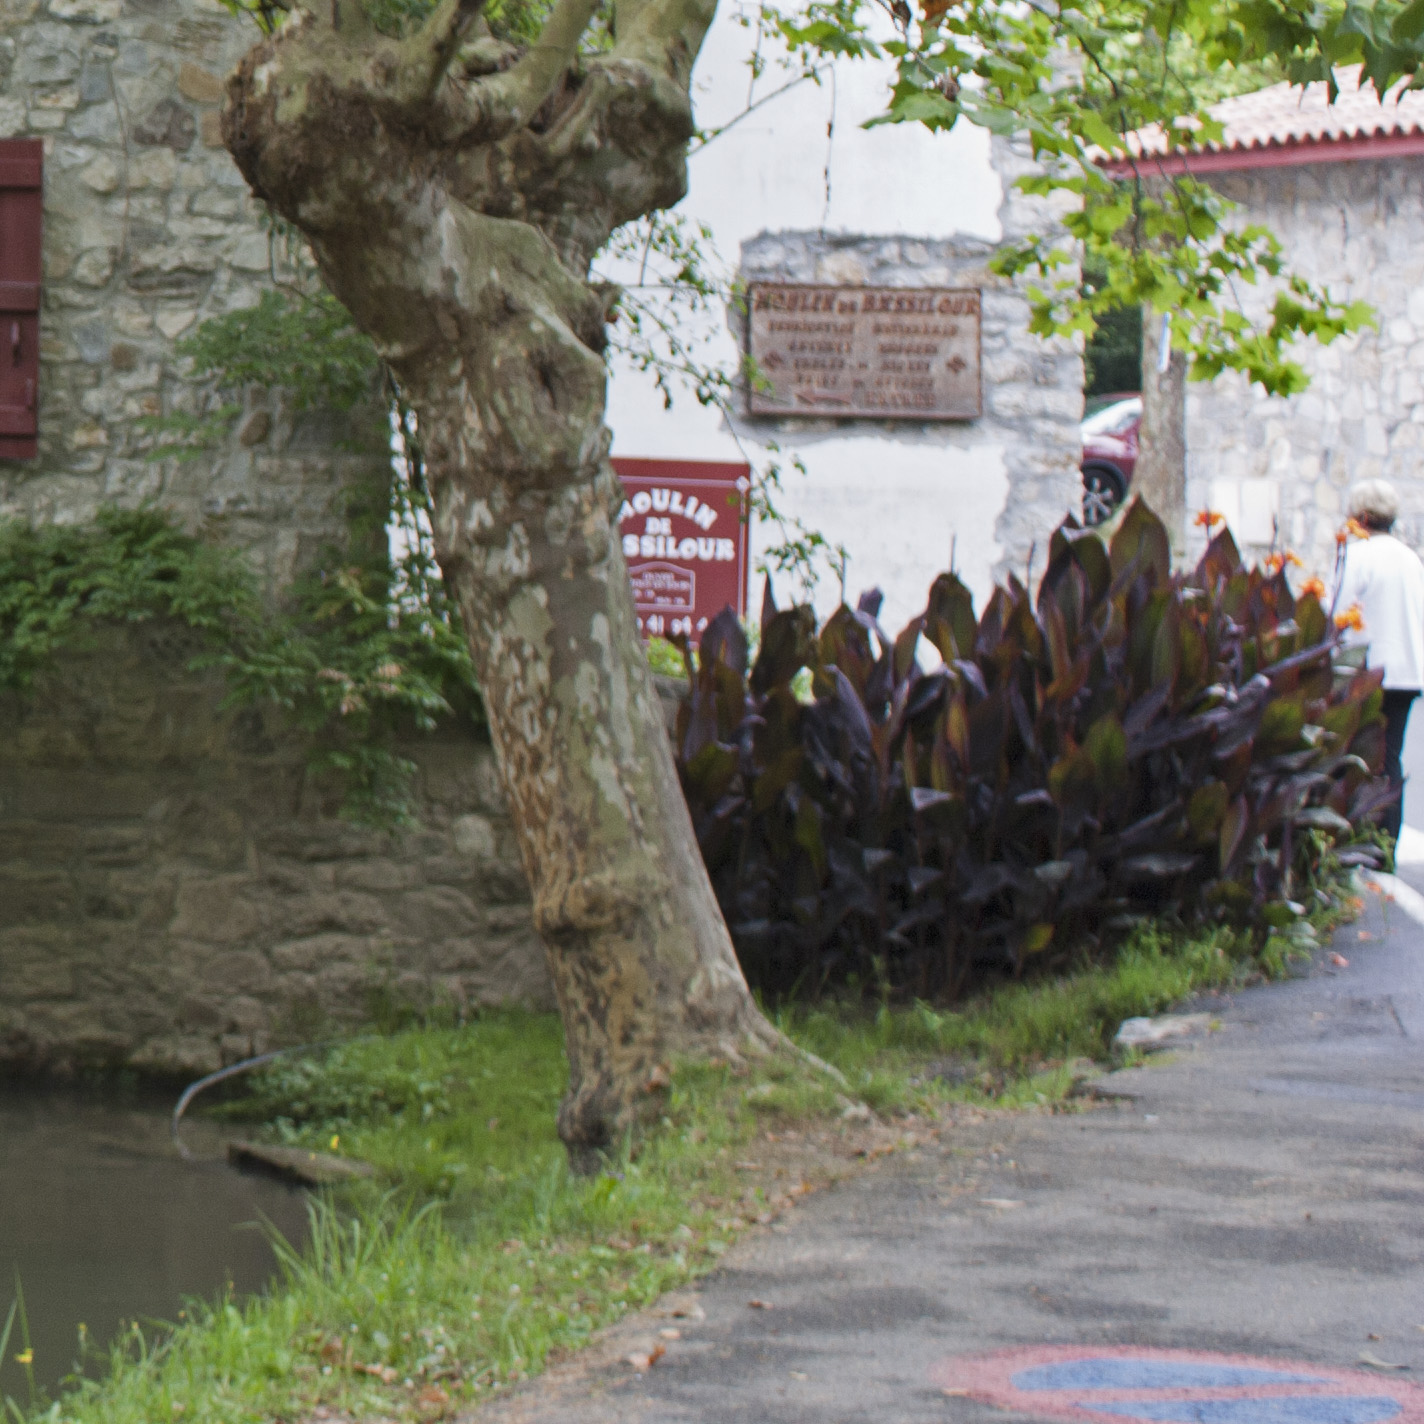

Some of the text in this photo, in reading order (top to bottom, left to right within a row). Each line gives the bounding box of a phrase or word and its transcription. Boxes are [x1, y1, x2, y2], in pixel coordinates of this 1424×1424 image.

[754, 291, 835, 312] MOULIN
[838, 299, 858, 314] DE
[645, 516, 673, 536] DE
[621, 533, 735, 561] SSILOUR
